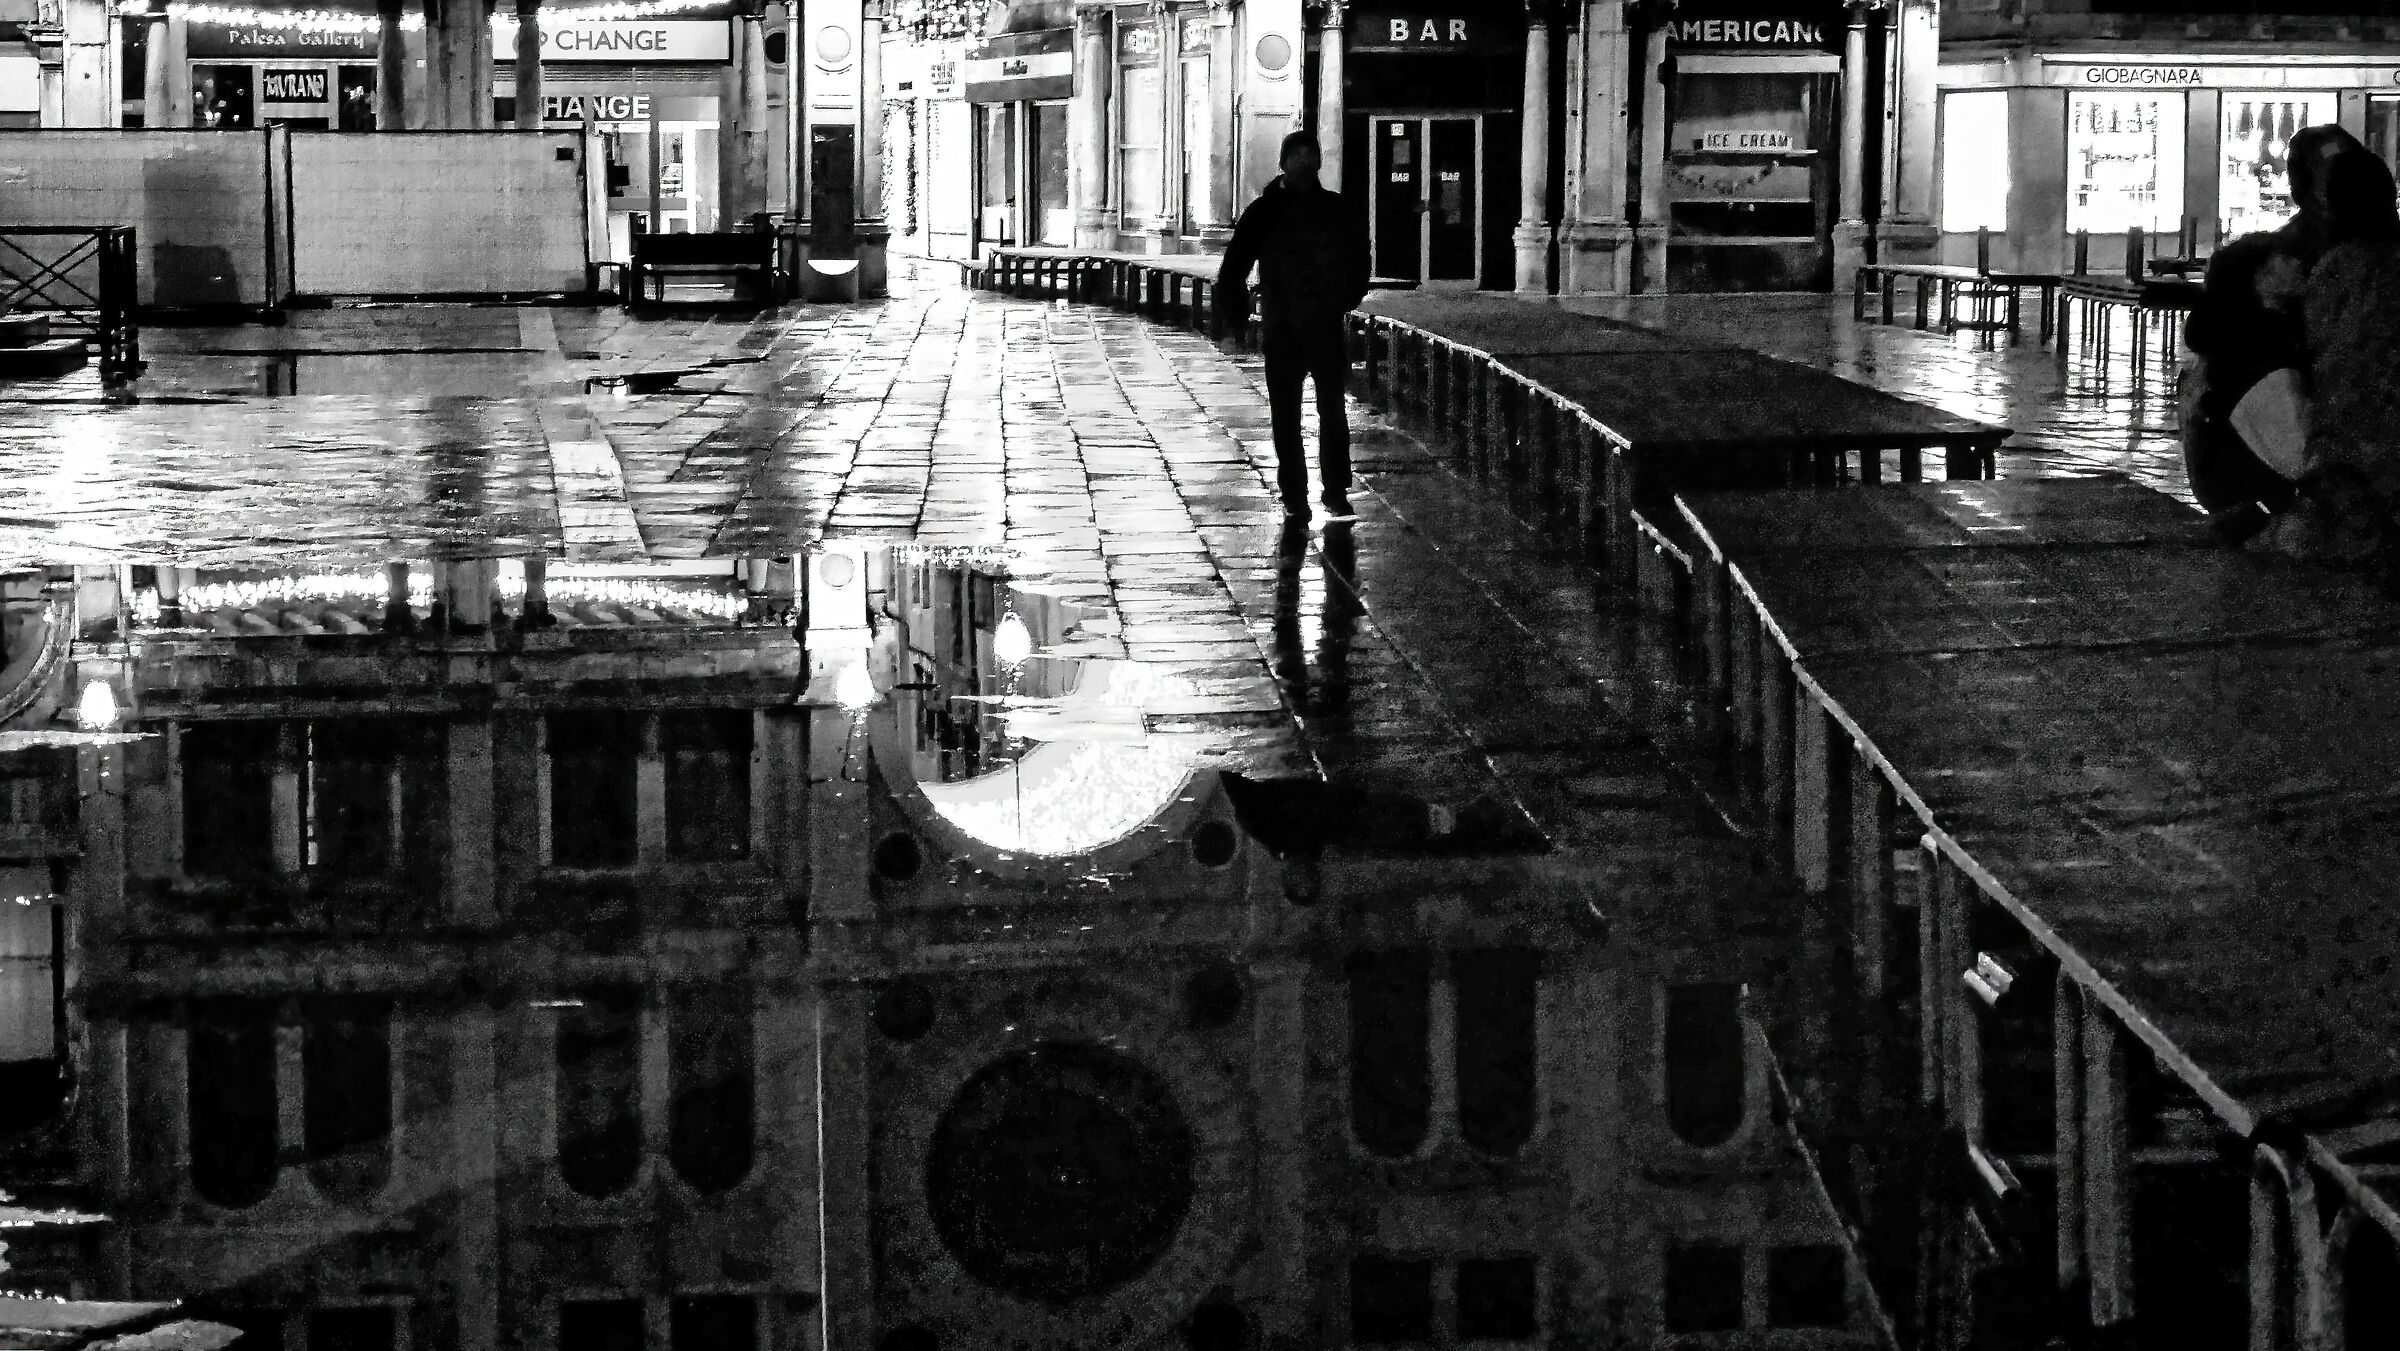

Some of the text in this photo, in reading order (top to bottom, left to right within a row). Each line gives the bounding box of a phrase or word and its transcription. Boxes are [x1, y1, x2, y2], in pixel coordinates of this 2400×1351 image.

[1390, 19, 1467, 41] BAR
[299, 31, 365, 49] Gallery
[555, 29, 667, 51] CHANGE
[2086, 67, 2202, 84] GIOBAGNARA
[544, 96, 651, 119] HANGE
[1706, 133, 1788, 148] ICE CREAM
[1441, 171, 1460, 181] BAR
